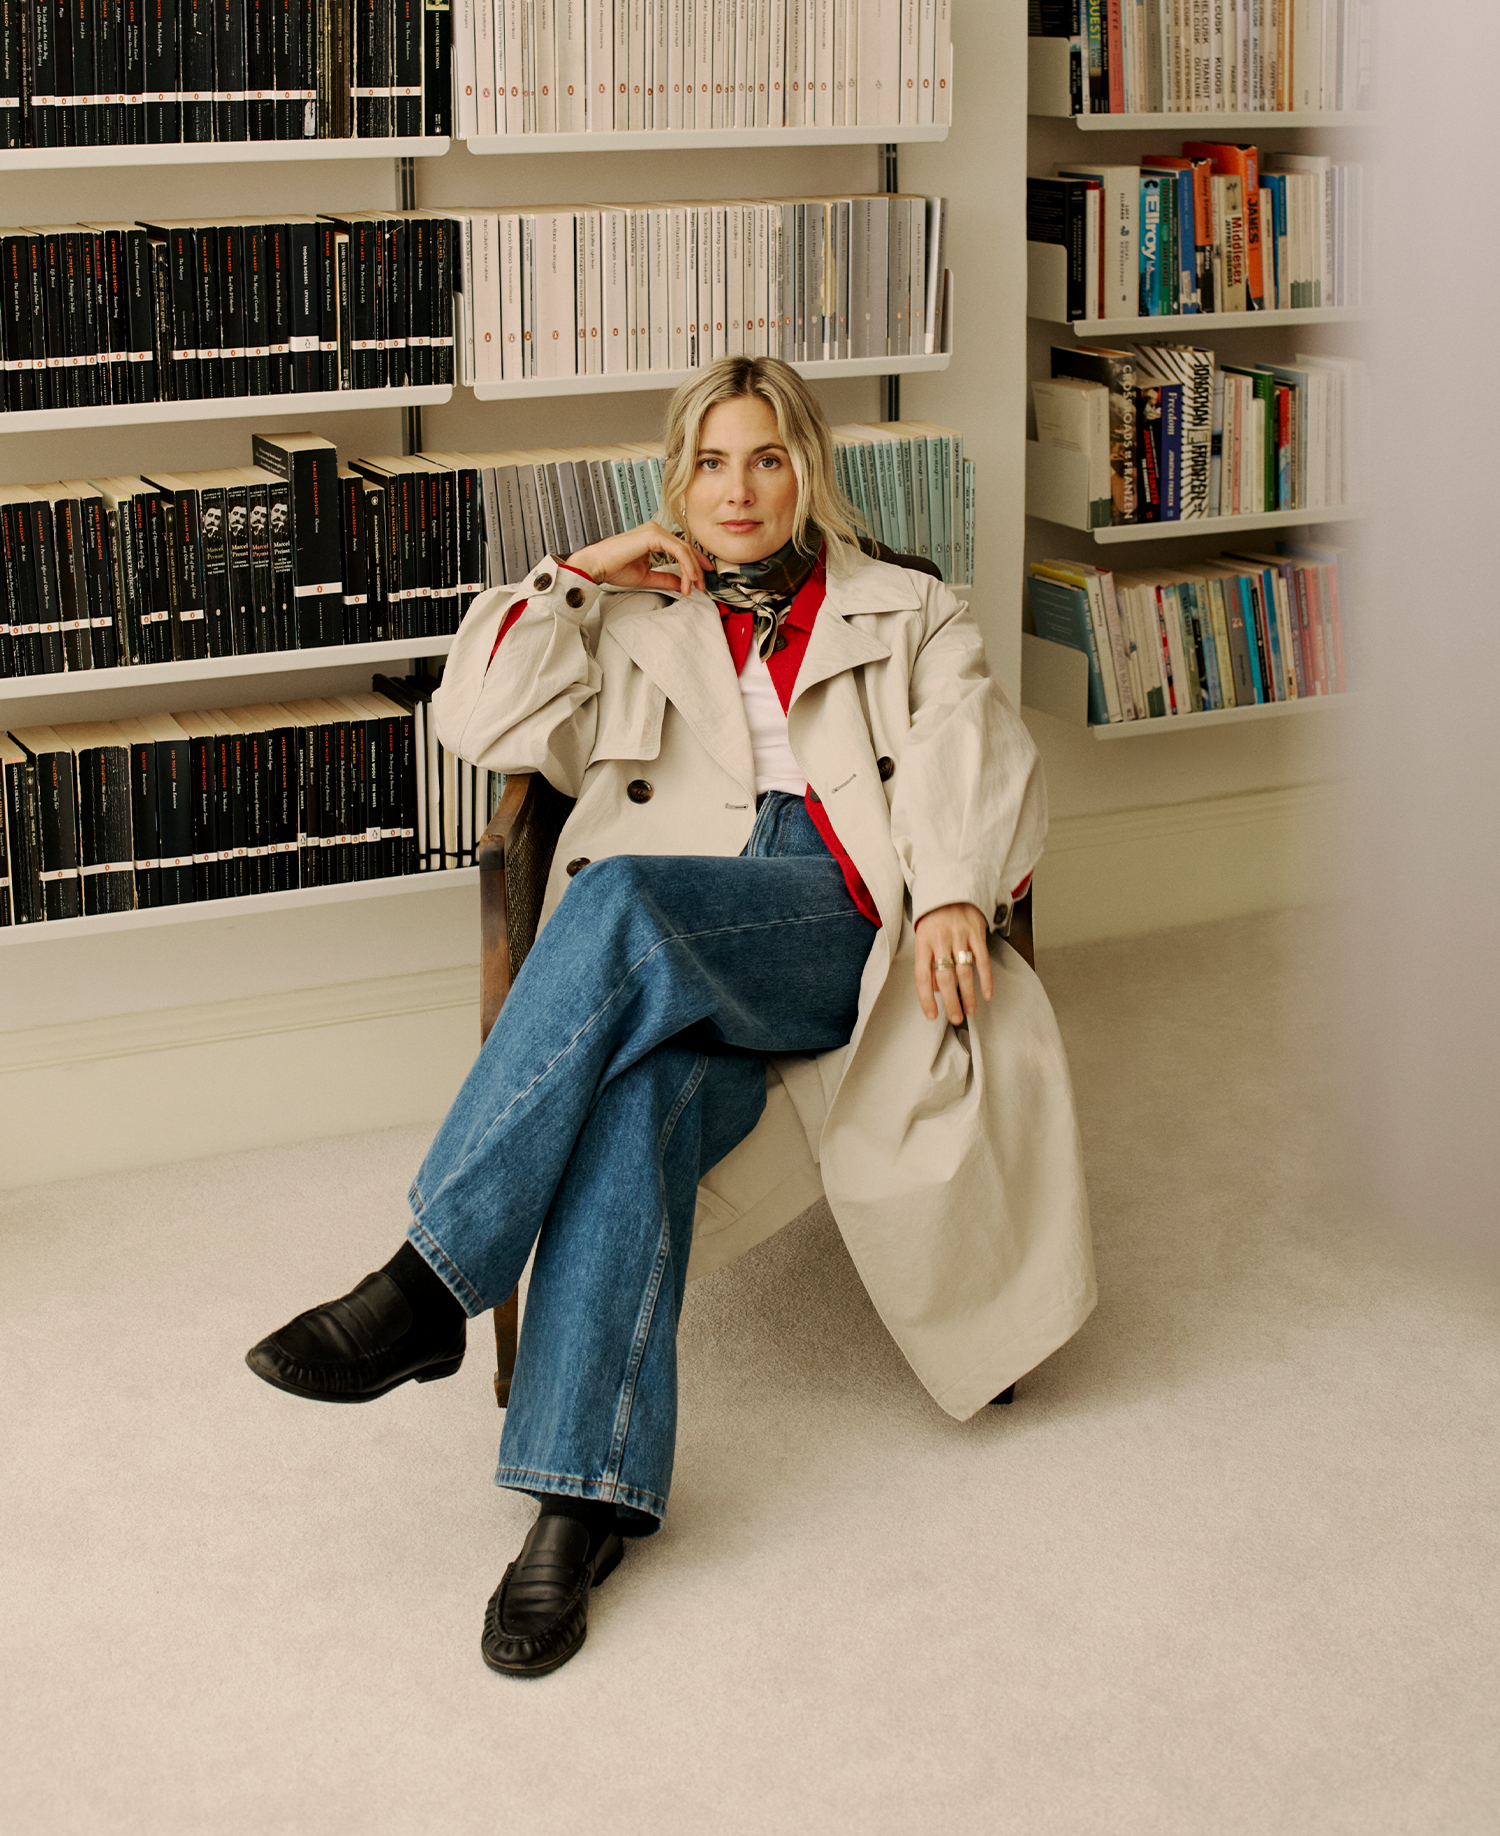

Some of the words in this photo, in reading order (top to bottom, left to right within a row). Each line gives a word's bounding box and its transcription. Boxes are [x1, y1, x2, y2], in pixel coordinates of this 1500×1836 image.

[1202, 58, 1210, 99] TRANSIT
[1141, 195, 1160, 260] Ellroy
[1248, 198, 1258, 244] JAMES
[1226, 250, 1234, 287] EUGENIDES
[1232, 216, 1243, 285] Middlesex
[1122, 364, 1133, 448] CROSSROADS
[1167, 392, 1177, 435] Freedom
[1192, 364, 1210, 427] JONATHAN
[1143, 429, 1155, 469] JONATHAN
[1123, 462, 1133, 519] FRANZEN
[1148, 469, 1159, 505] FRANZEN
[1190, 444, 1208, 502] FRANZEN
[1094, 593, 1104, 627] Asymmetry
